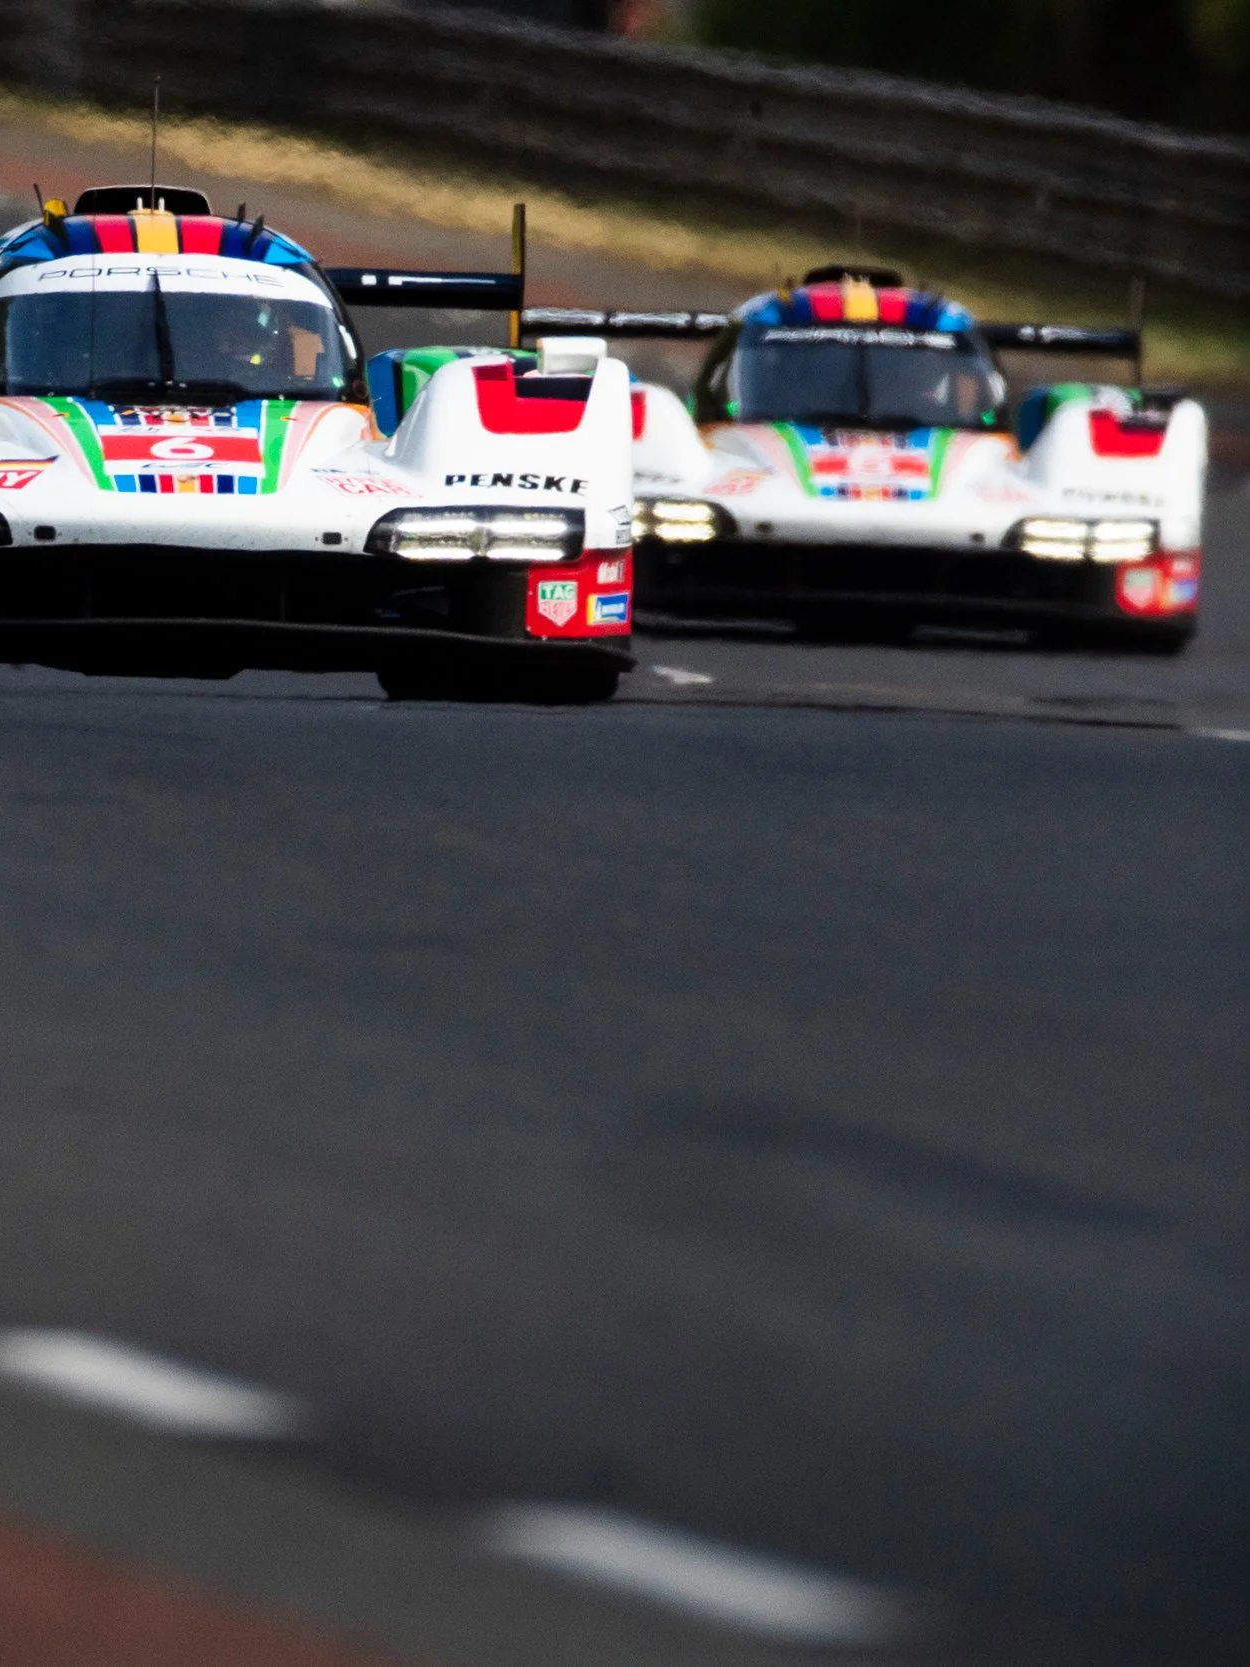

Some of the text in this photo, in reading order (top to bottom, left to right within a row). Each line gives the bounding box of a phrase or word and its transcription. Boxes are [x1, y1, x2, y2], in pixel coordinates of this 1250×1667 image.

[37, 267, 284, 287] PORSCHE
[151, 437, 214, 460] 6
[444, 472, 589, 496] PENSKE
[540, 583, 577, 600] TAG
